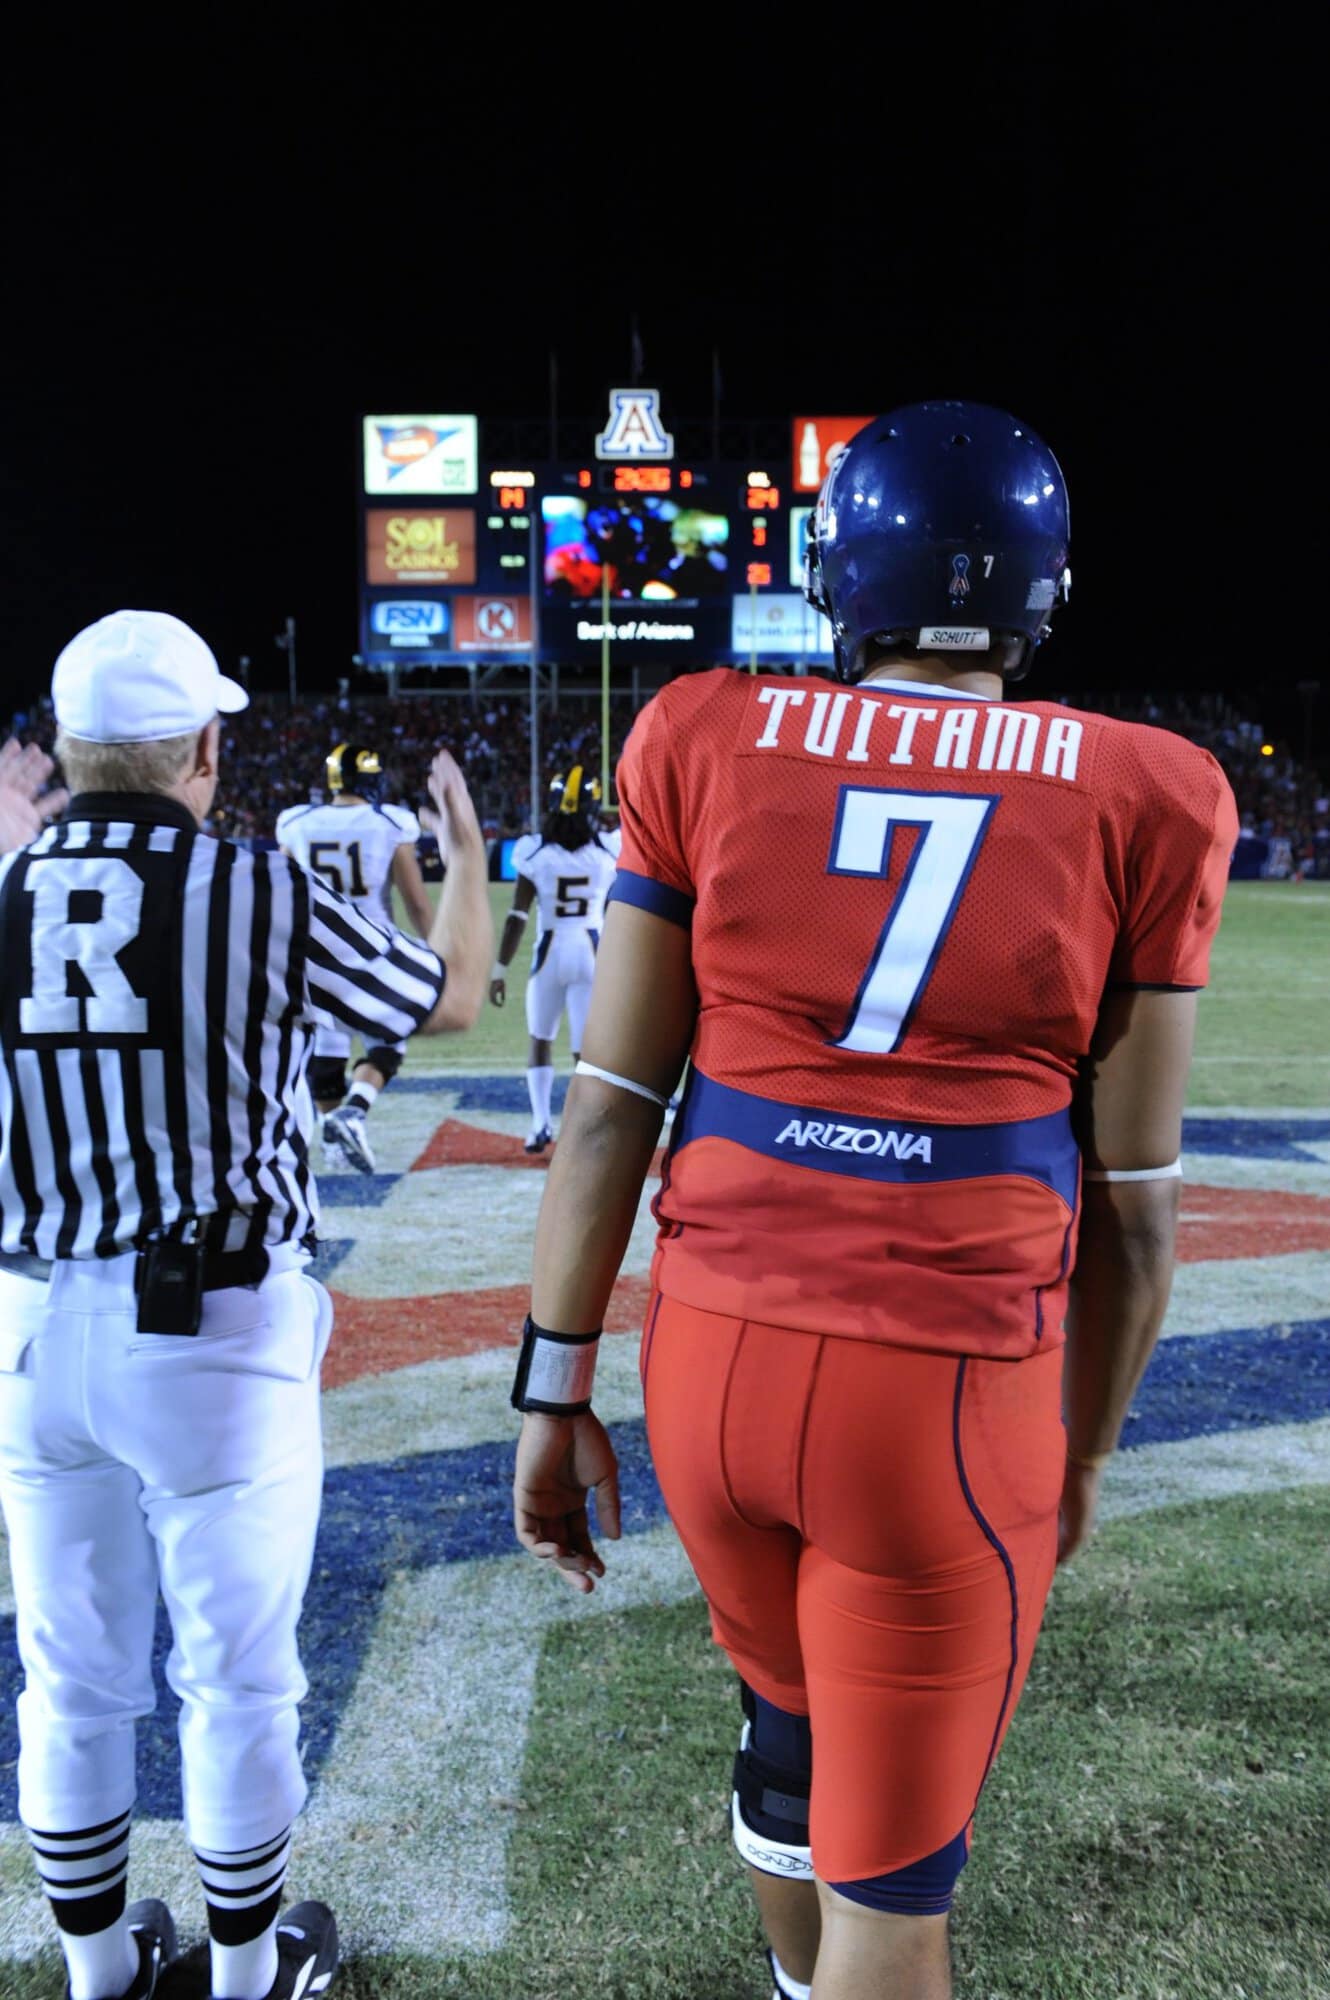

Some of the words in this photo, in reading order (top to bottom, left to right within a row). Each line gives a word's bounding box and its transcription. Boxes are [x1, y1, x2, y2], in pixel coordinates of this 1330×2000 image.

[596, 389, 674, 460] A
[983, 555, 995, 579] 7
[617, 621, 636, 640] of
[635, 621, 694, 640] Arizona
[930, 630, 982, 645] SCHUTT
[755, 686, 1084, 781] TUITAMA
[309, 841, 369, 896] 51
[555, 876, 590, 917] 5
[824, 783, 1004, 1055] 7
[20, 857, 149, 1034] R
[774, 1119, 933, 1164] ARIZONA
